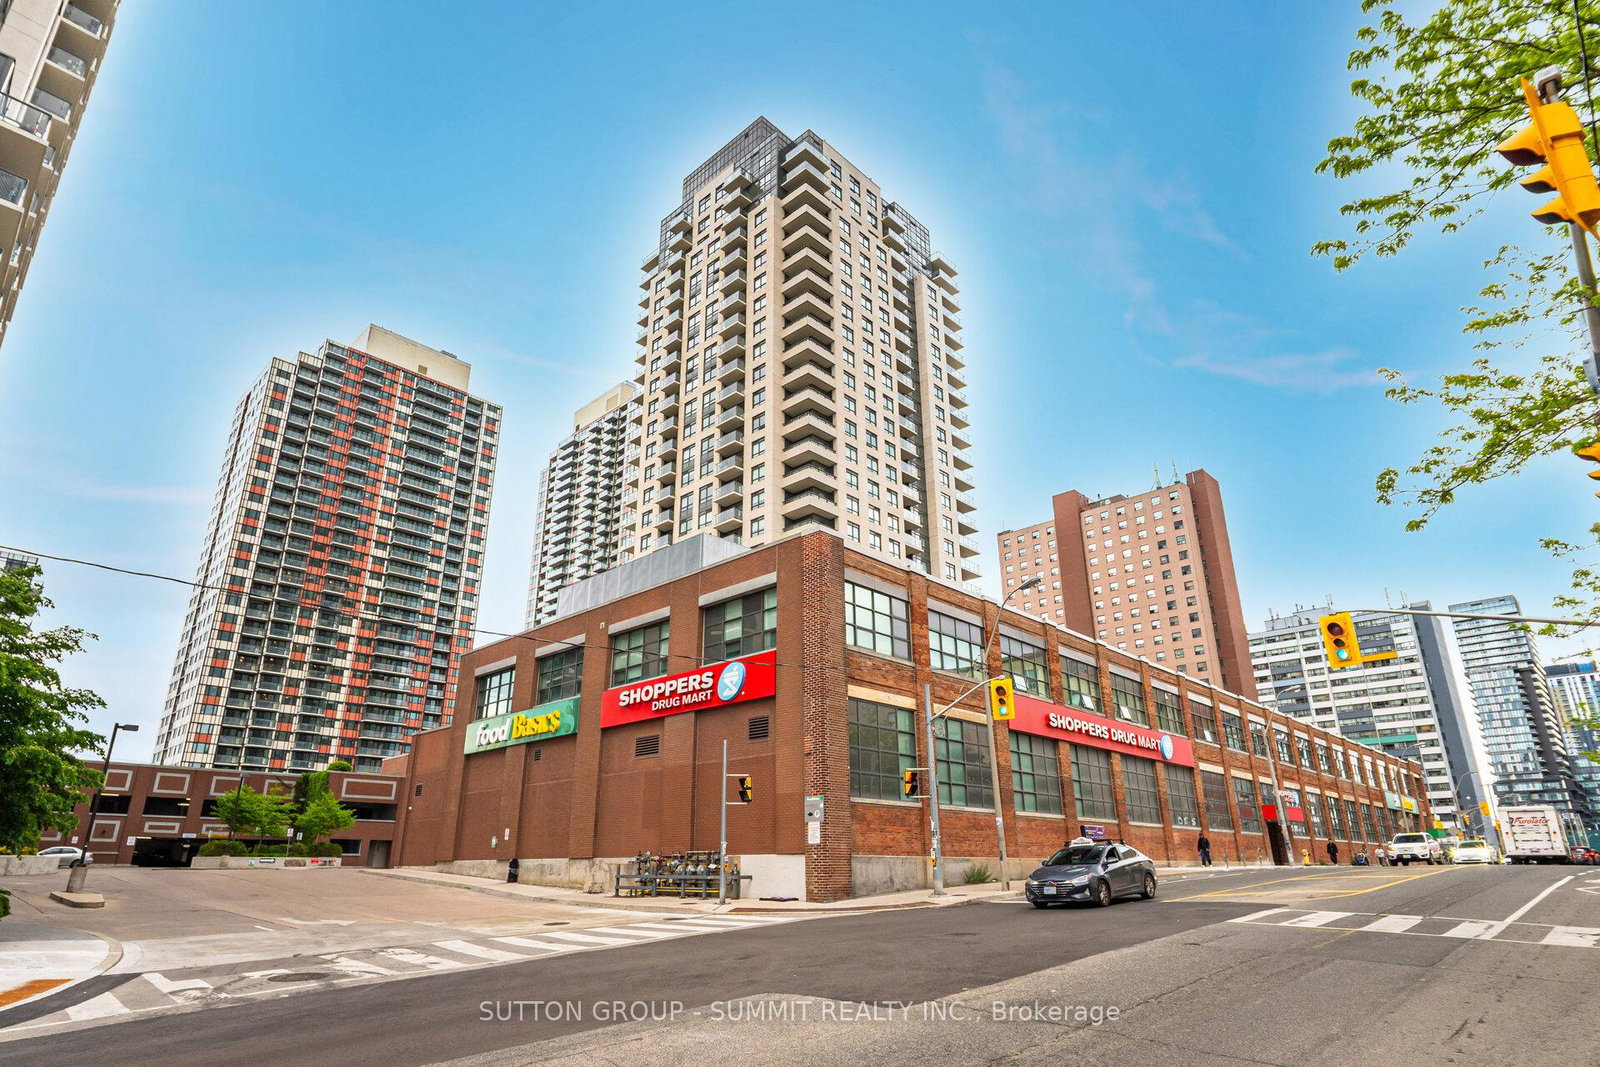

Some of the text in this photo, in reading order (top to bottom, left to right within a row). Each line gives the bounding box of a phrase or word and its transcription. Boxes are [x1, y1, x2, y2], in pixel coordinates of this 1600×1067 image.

[618, 671, 714, 707] SHOPPERS
[651, 690, 713, 711] DRUG MART
[475, 717, 513, 747] food
[1049, 712, 1161, 751] SHOPPERS DRUG MART
